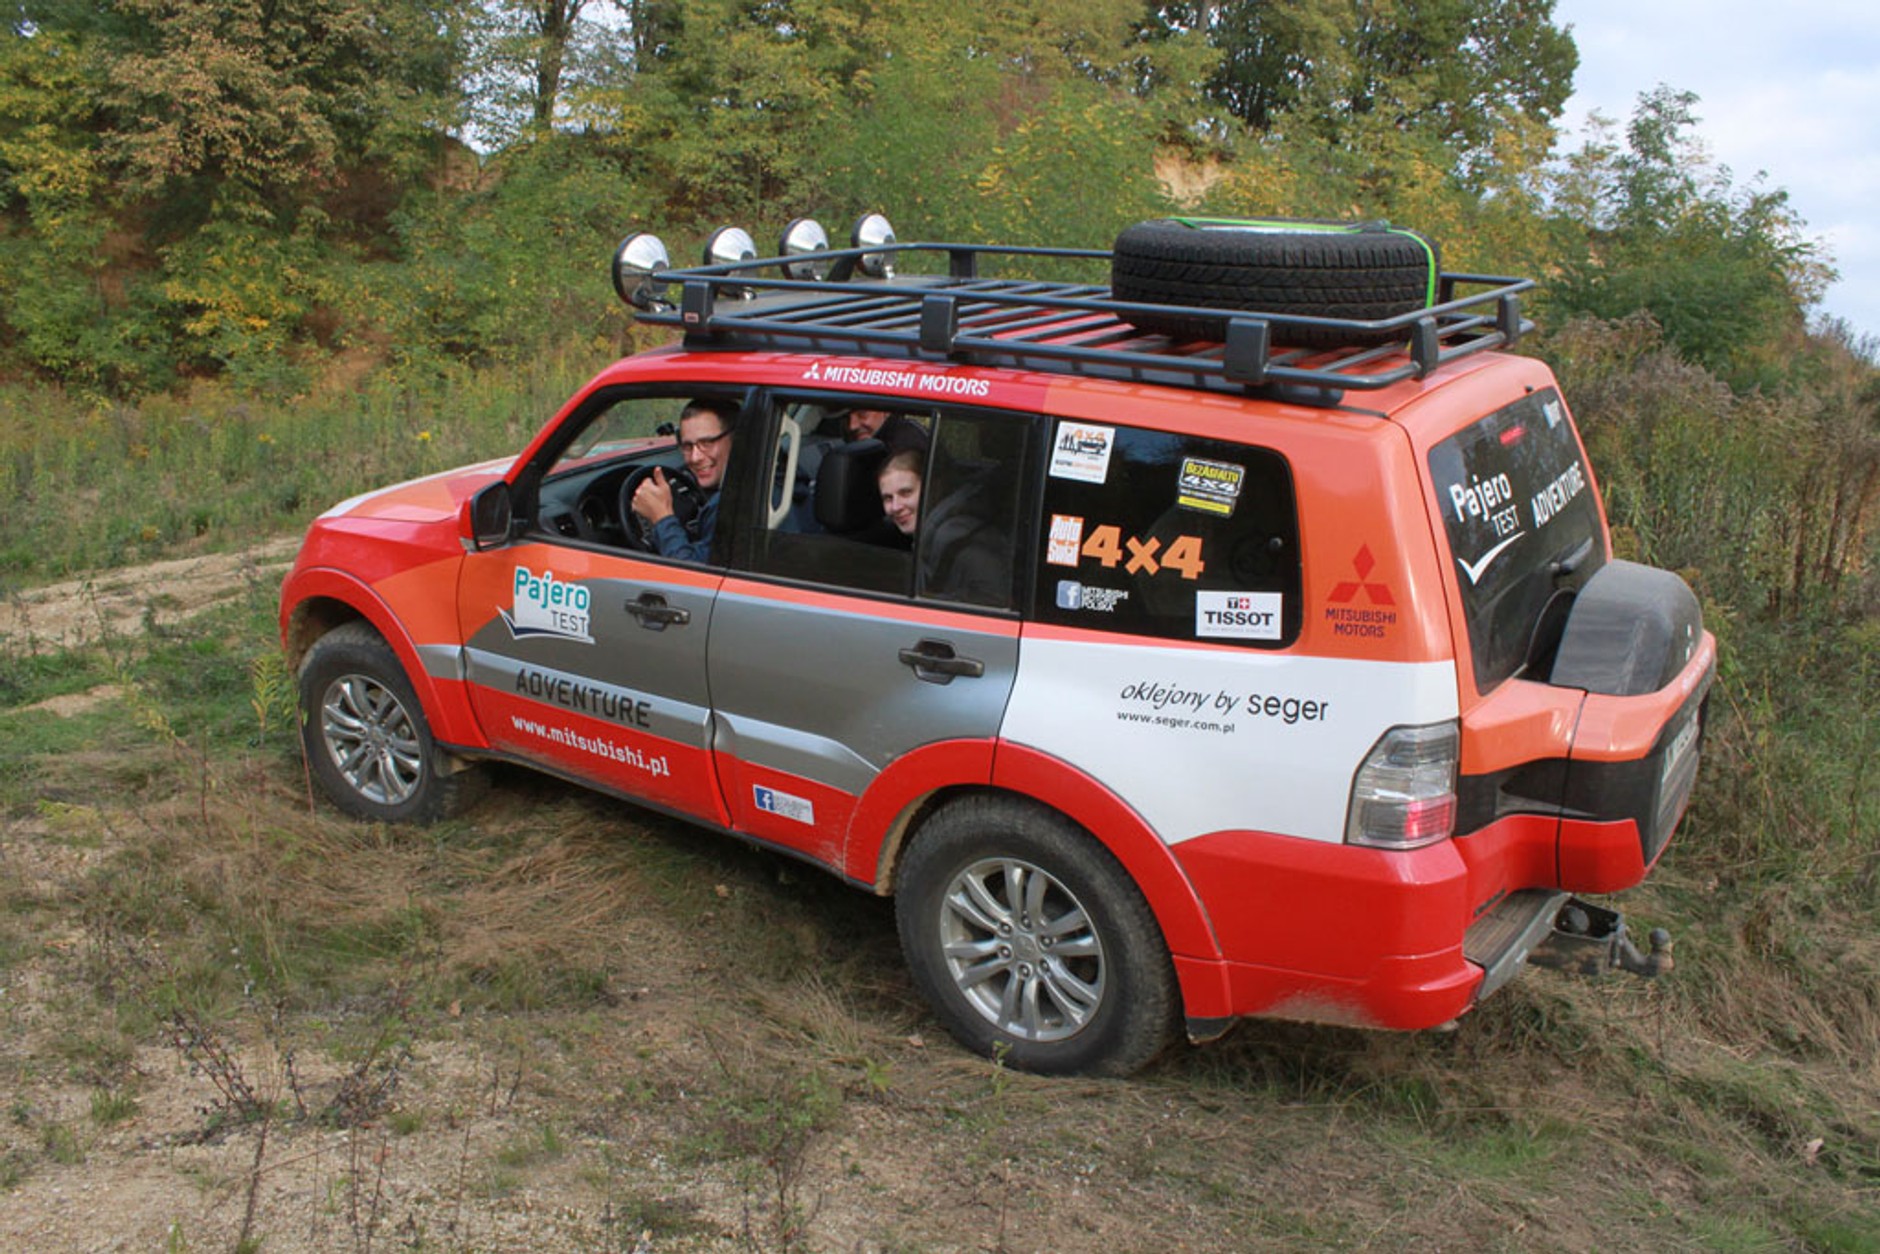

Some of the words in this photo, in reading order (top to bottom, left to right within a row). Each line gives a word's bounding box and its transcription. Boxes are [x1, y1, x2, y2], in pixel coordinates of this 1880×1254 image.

[823, 366, 914, 389] MITSUBISHI
[919, 374, 990, 396] MOTORS
[1449, 472, 1512, 522] Pajero
[1531, 461, 1585, 528] ADVENTURE
[1491, 504, 1520, 537] TEST
[1082, 524, 1205, 580] 4x4
[515, 568, 588, 610] Pajero
[551, 610, 587, 633] TEST
[1204, 611, 1274, 626] TISSOT
[1325, 608, 1397, 624] MITSUBISHI
[1334, 622, 1385, 638] MOTORS
[516, 668, 652, 728] ADVENTURE
[1120, 681, 1210, 713] oklejony
[1214, 690, 1240, 716] by
[1246, 694, 1329, 725] seger
[1117, 710, 1235, 734] www.seger.com.pl
[511, 715, 670, 776] www.mitsubishi.pl
